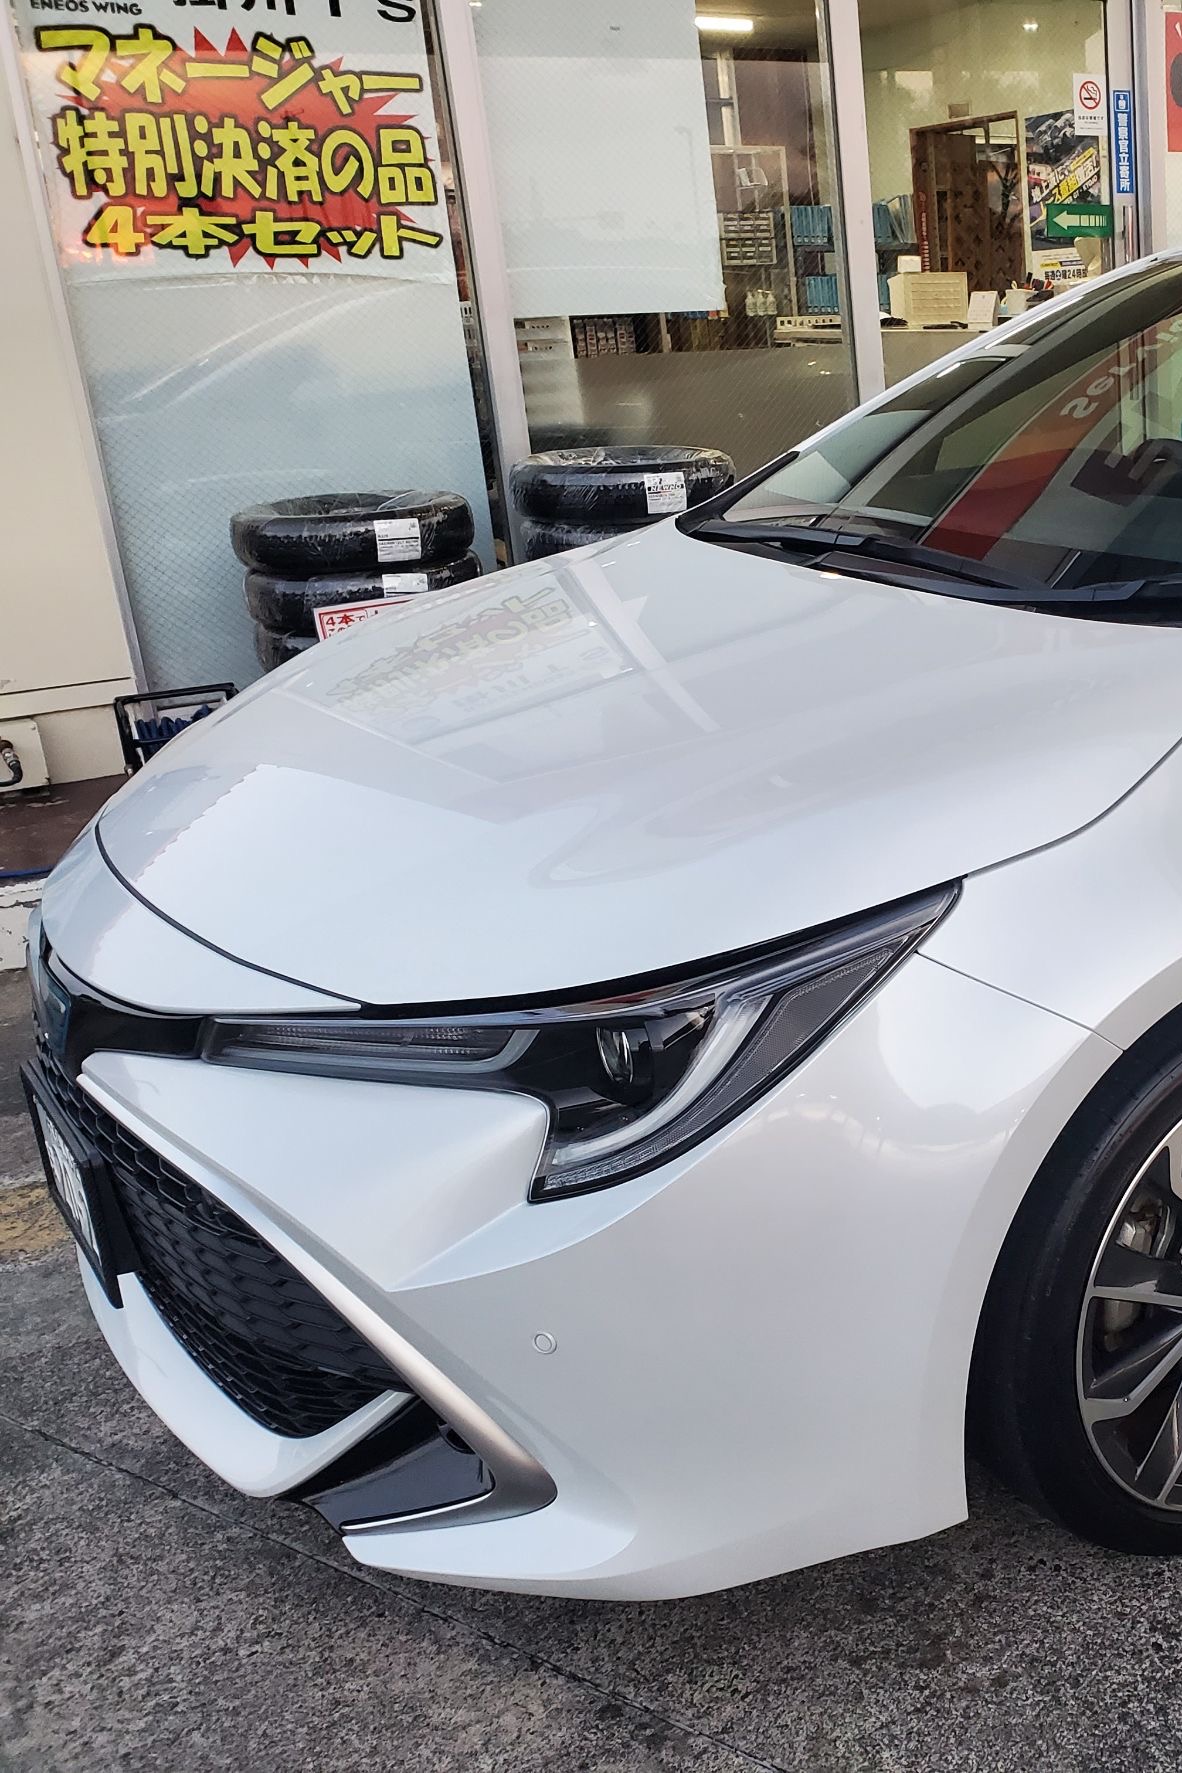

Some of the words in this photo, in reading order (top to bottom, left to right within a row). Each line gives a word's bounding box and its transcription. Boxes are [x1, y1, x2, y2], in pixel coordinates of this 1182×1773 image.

[93, 1, 143, 16] WING
[35, 24, 423, 116] マネージャー
[54, 106, 439, 204] 特別決済の品
[84, 205, 442, 259] 4本セット
